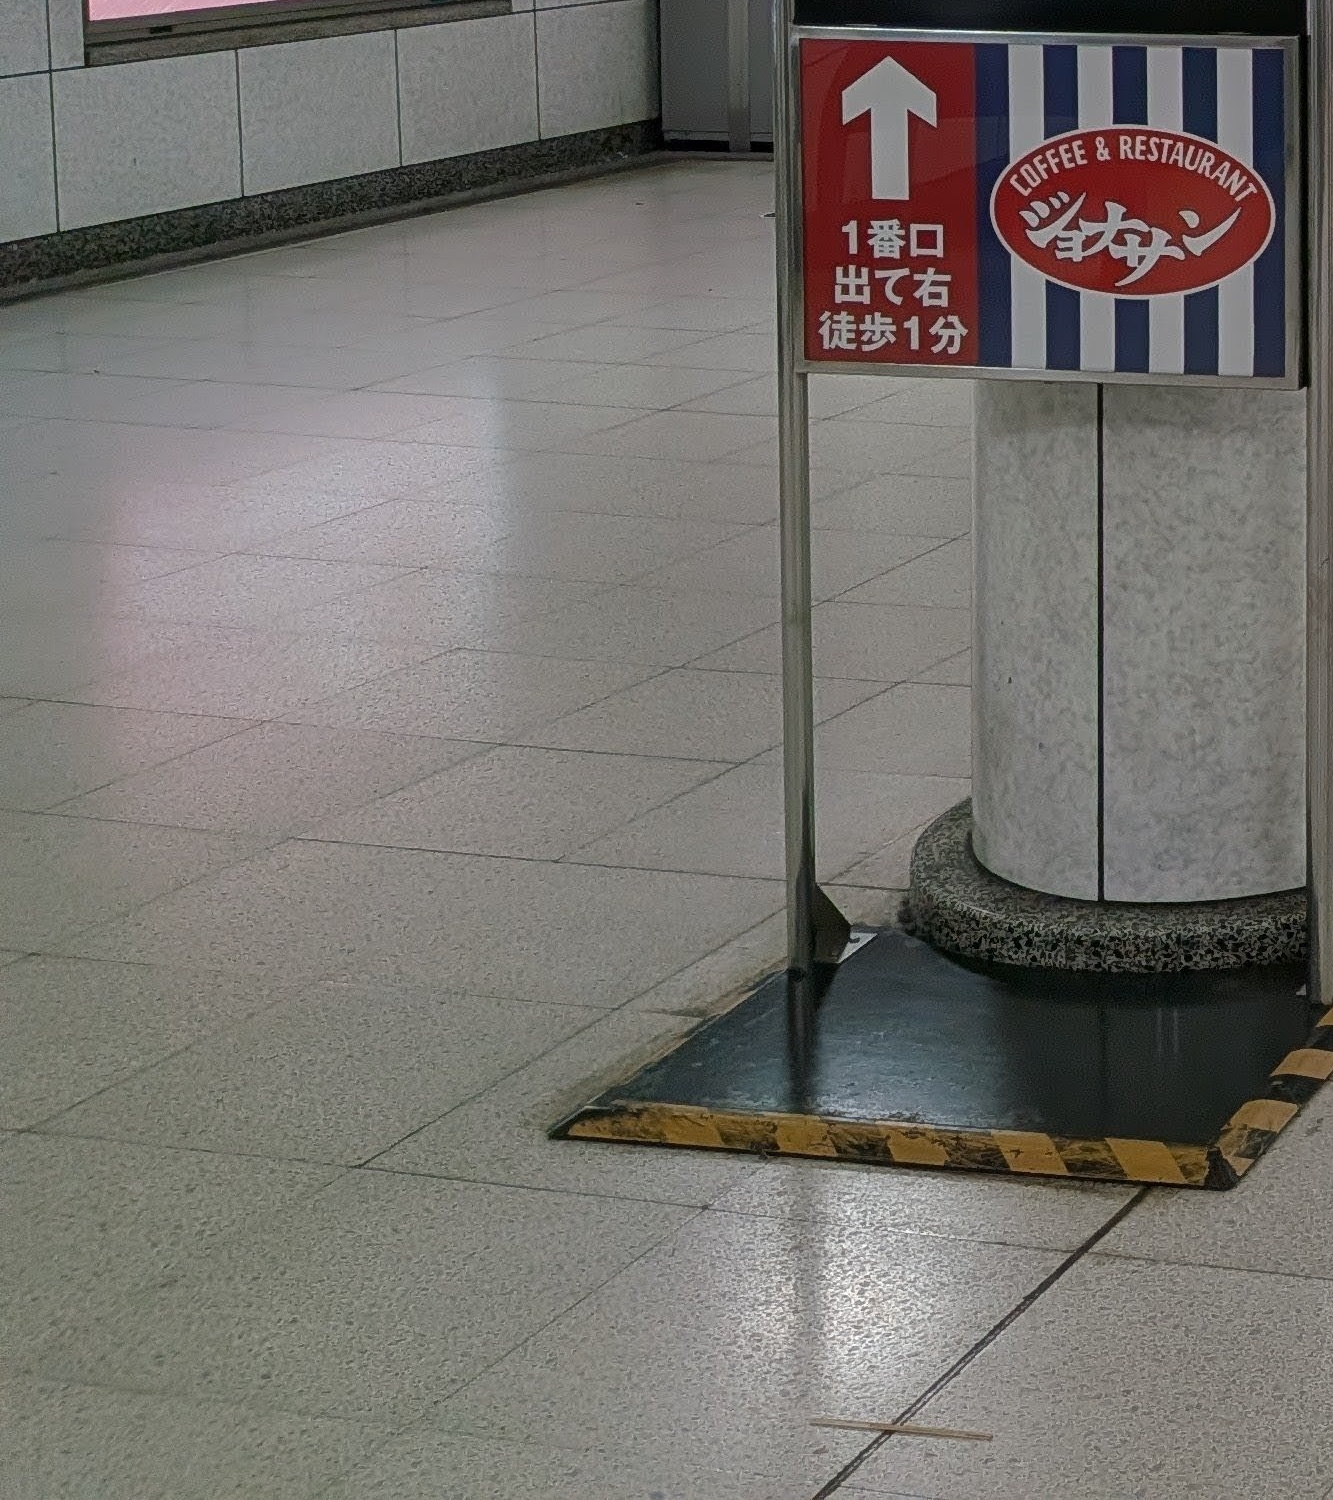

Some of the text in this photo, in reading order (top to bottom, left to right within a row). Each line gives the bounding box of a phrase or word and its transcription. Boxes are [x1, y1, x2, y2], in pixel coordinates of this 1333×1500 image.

[1010, 135, 1258, 202] COFFEE & RESTAURANT
[841, 218, 945, 259] 1番口
[1018, 190, 1242, 287] ジョナサン
[834, 265, 952, 308] 出て右
[818, 311, 969, 354] 徒歩1分
